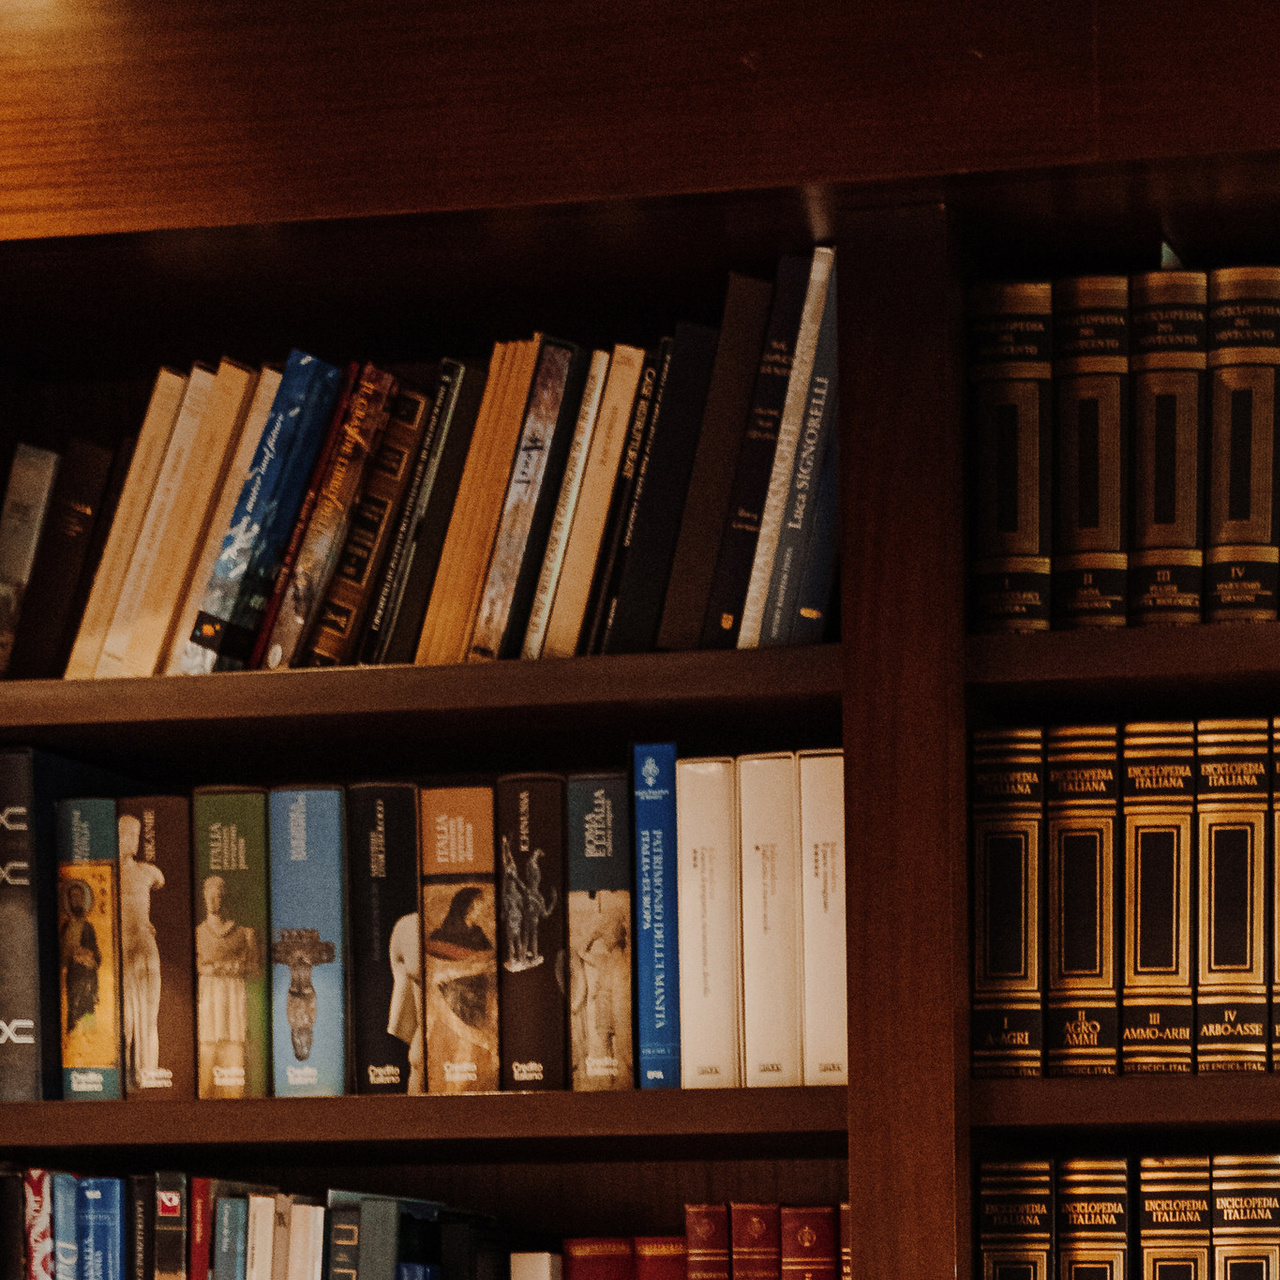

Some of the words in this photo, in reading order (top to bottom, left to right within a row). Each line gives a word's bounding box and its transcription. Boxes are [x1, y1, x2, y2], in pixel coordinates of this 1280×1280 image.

[1208, 774, 1258, 787] ITALIANA
[1149, 1013, 1160, 1025] III
[1224, 1010, 1237, 1022] IV
[1064, 1021, 1100, 1034] AGRO
[1123, 1027, 1190, 1040] AMMO-ARBI
[1201, 1022, 1263, 1036] ARBO-ASSE
[1064, 1033, 1098, 1045] AMMI
[1145, 1199, 1208, 1211] ENCICLOPEDIA
[1216, 1197, 1279, 1209] ENCICLOPEDIA
[1152, 1211, 1200, 1222] ITALIANA
[1224, 1209, 1272, 1220] ITALIANA
